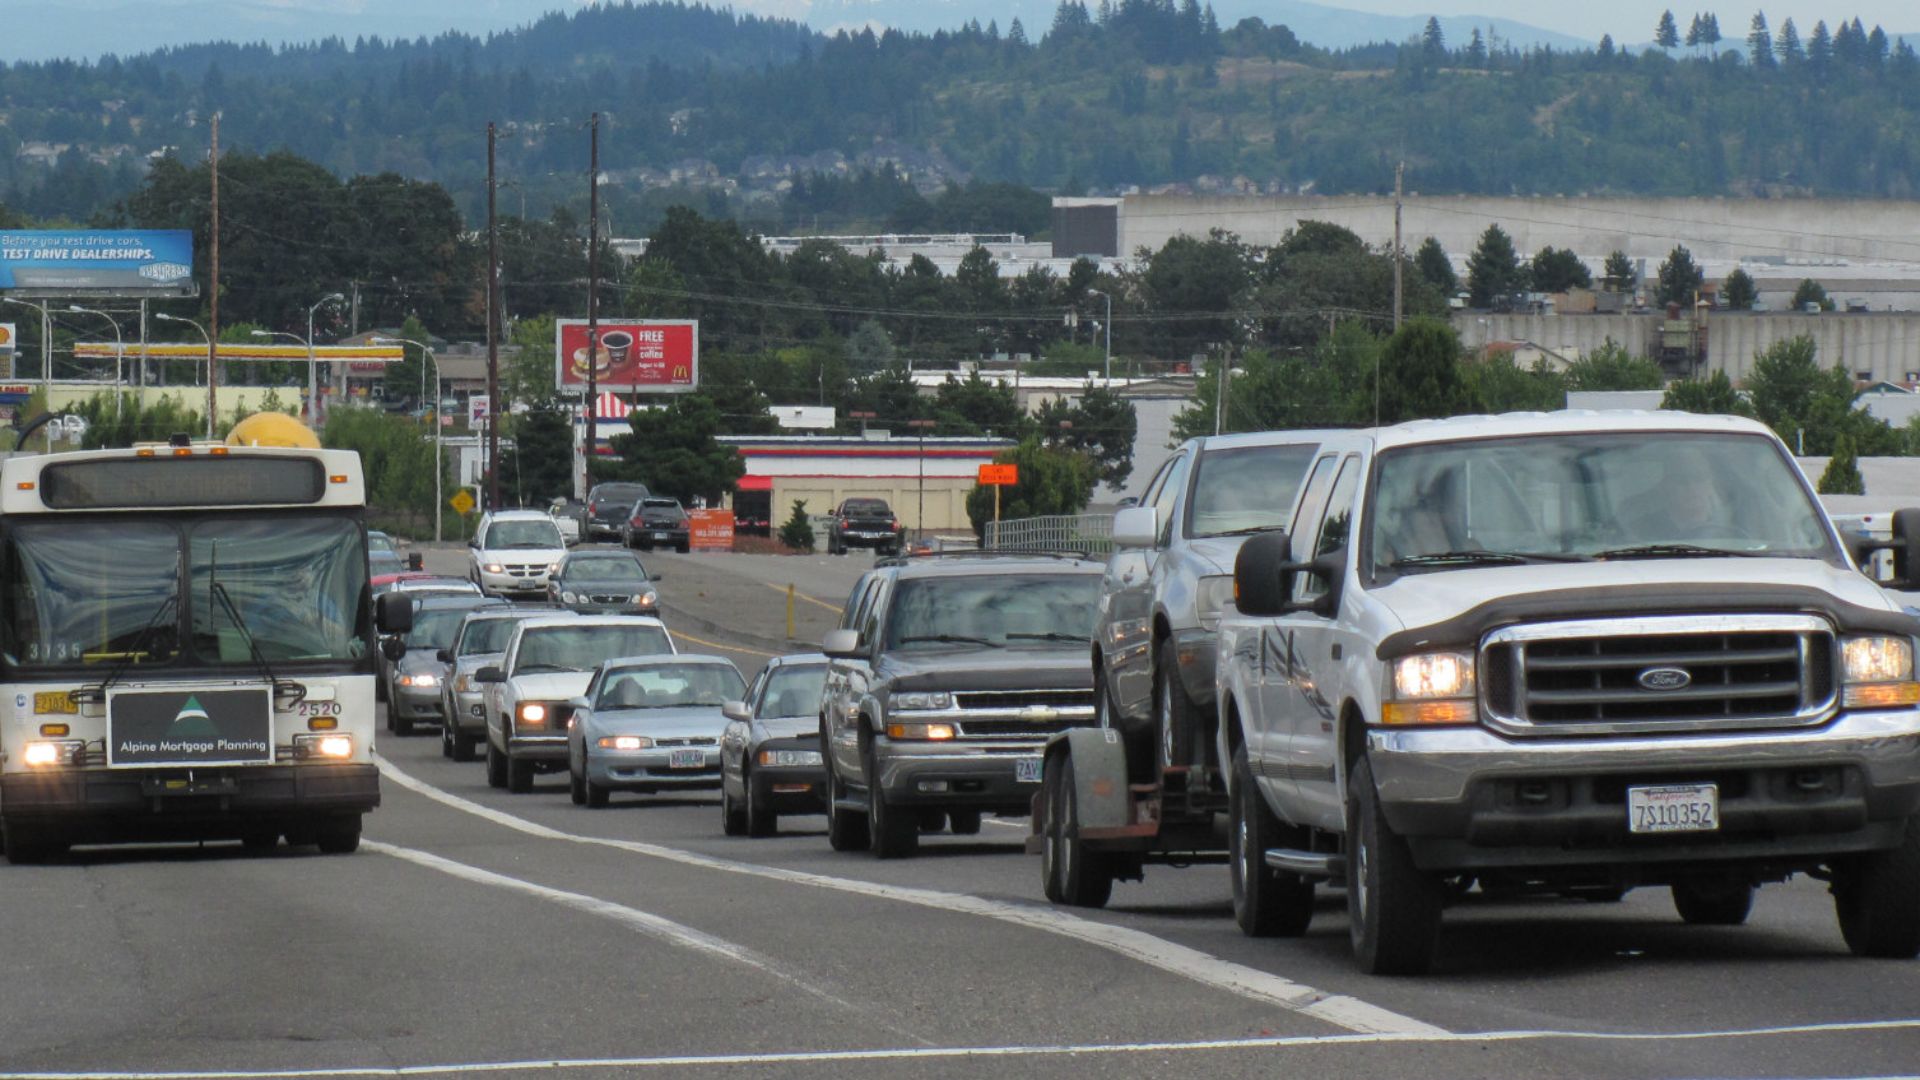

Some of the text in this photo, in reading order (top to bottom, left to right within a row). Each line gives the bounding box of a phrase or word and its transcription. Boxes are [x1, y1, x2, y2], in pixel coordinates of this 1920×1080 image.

[2, 235, 37, 246] Before
[40, 238, 59, 247] you
[63, 237, 83, 246] test
[86, 235, 114, 246] drive
[2, 249, 155, 260] TEST DRIVE DEALERSHIPS.
[639, 330, 665, 342] FREE
[299, 703, 342, 716] 2520
[120, 739, 266, 754] Alpine Mortgage Planning
[1635, 802, 1711, 827] 7S10352
